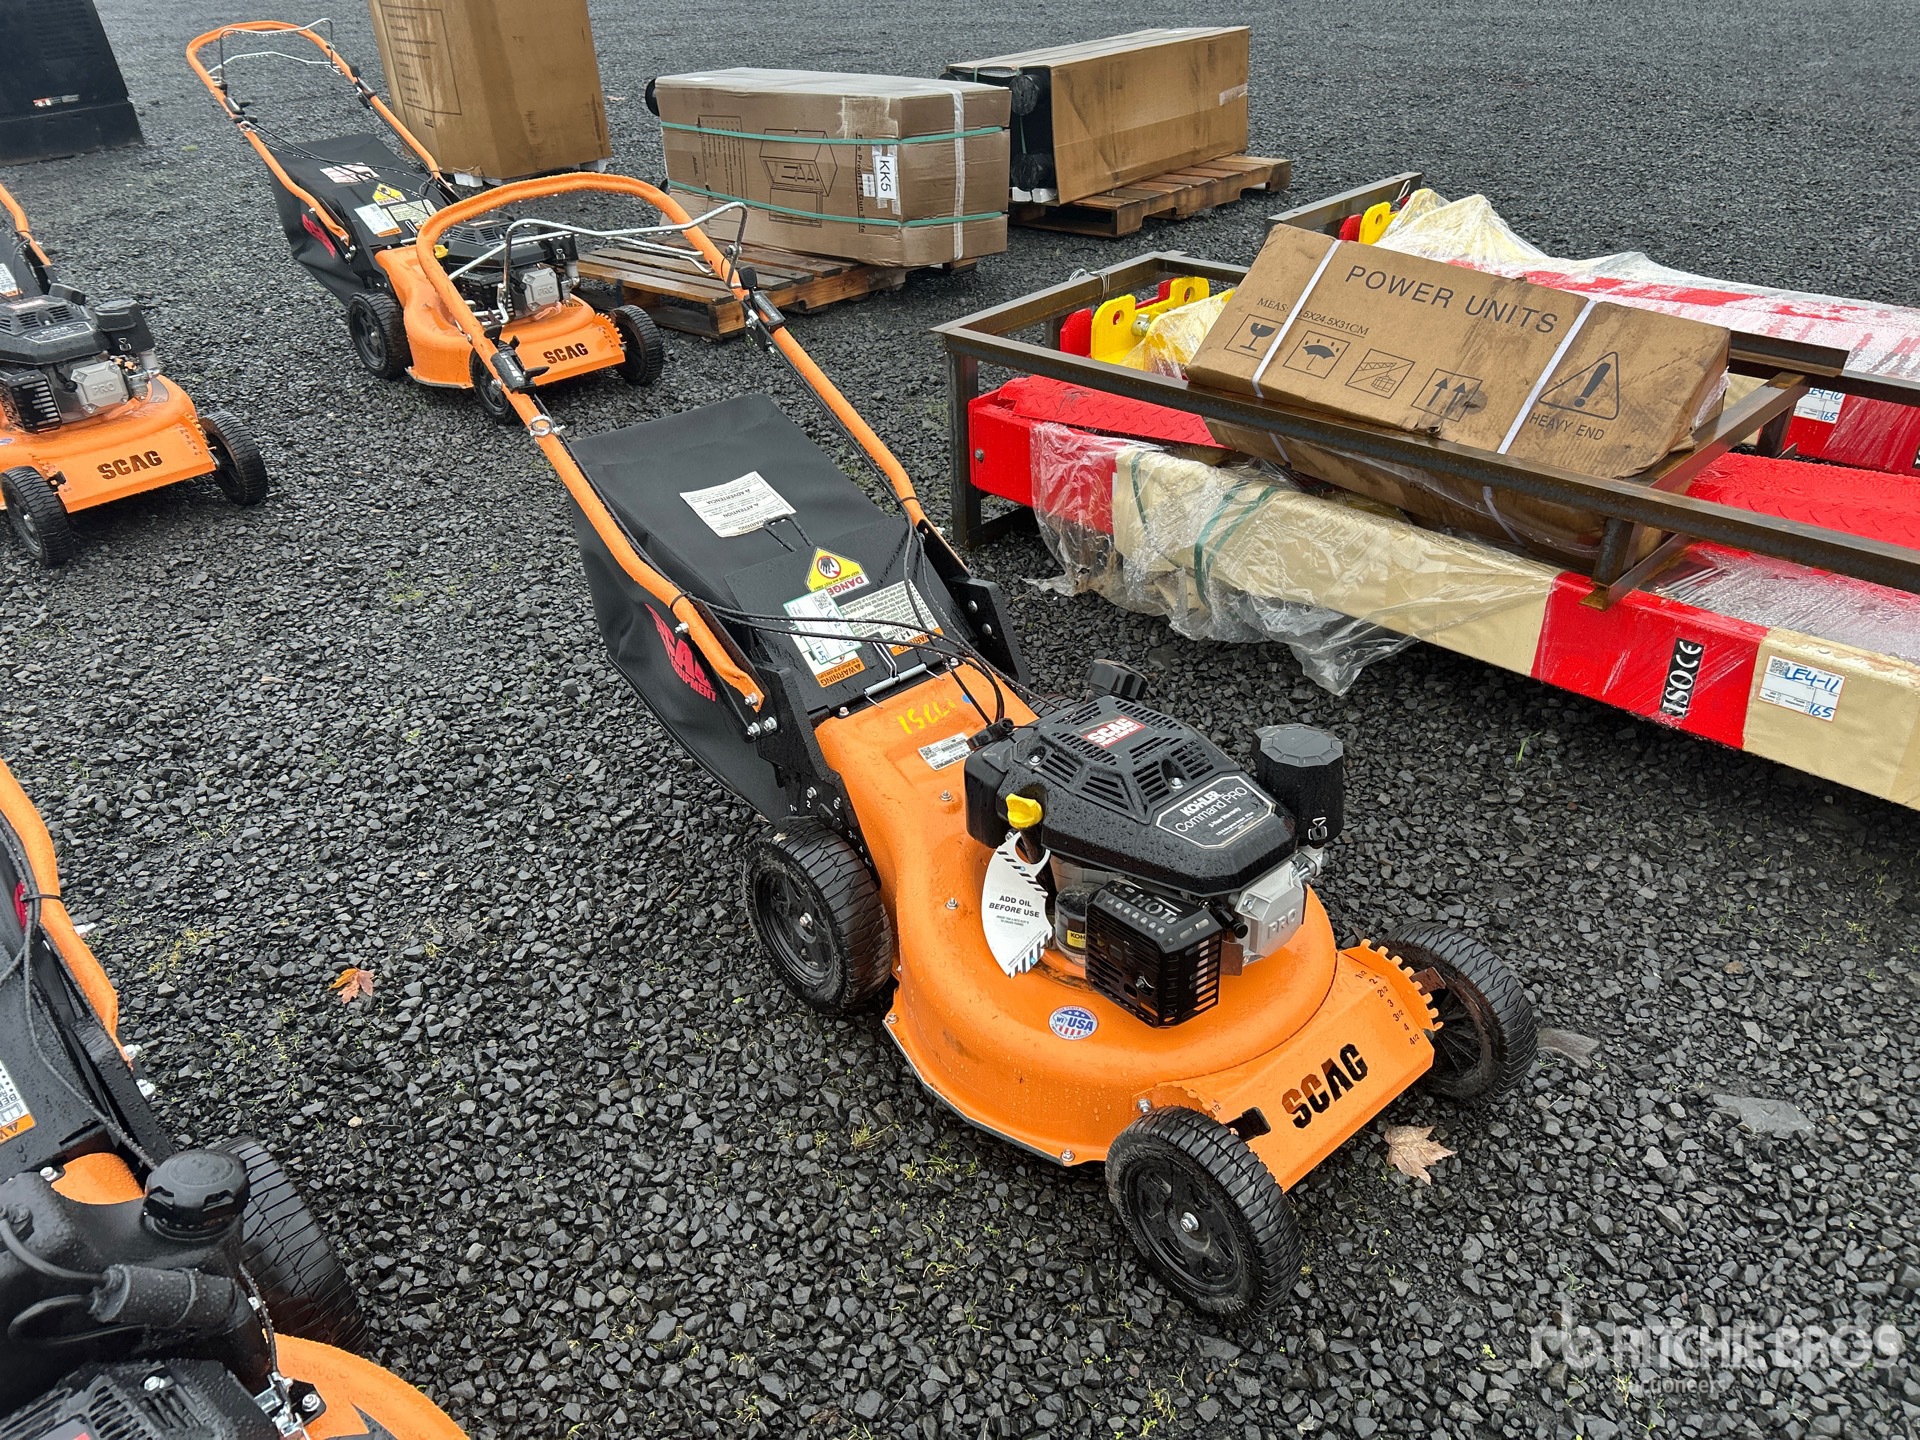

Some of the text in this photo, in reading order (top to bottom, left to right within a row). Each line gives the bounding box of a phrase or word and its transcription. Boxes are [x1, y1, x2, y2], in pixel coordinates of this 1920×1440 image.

[879, 160, 892, 192] KK5
[1256, 298, 1289, 312] MEAS:
[1345, 265, 1558, 333] POWER UNITS
[543, 343, 589, 364] SCAG
[91, 381, 115, 397] PRO
[1529, 412, 1605, 440] HEAVY END
[1820, 411, 1839, 421] 165
[97, 450, 163, 480] SCAG
[828, 576, 865, 595] DANGE
[820, 667, 857, 686] WARNING
[1662, 640, 1702, 715] ISO CE
[1784, 666, 1840, 692] LE4-11
[1808, 703, 1837, 718] 165
[1087, 718, 1136, 744] SCAG
[1175, 800, 1227, 832] Command
[1221, 787, 1248, 804] PRO
[1180, 790, 1222, 816] KOHLER
[989, 902, 1040, 918] BEFORE USE
[999, 895, 1032, 907] ADD OIL
[1268, 908, 1298, 938] PRO
[1070, 932, 1086, 940] KOH
[1387, 999, 1394, 1007] 3
[1067, 1016, 1093, 1031] USA
[1403, 1023, 1410, 1031] 4
[1282, 1043, 1368, 1129] SCAG
